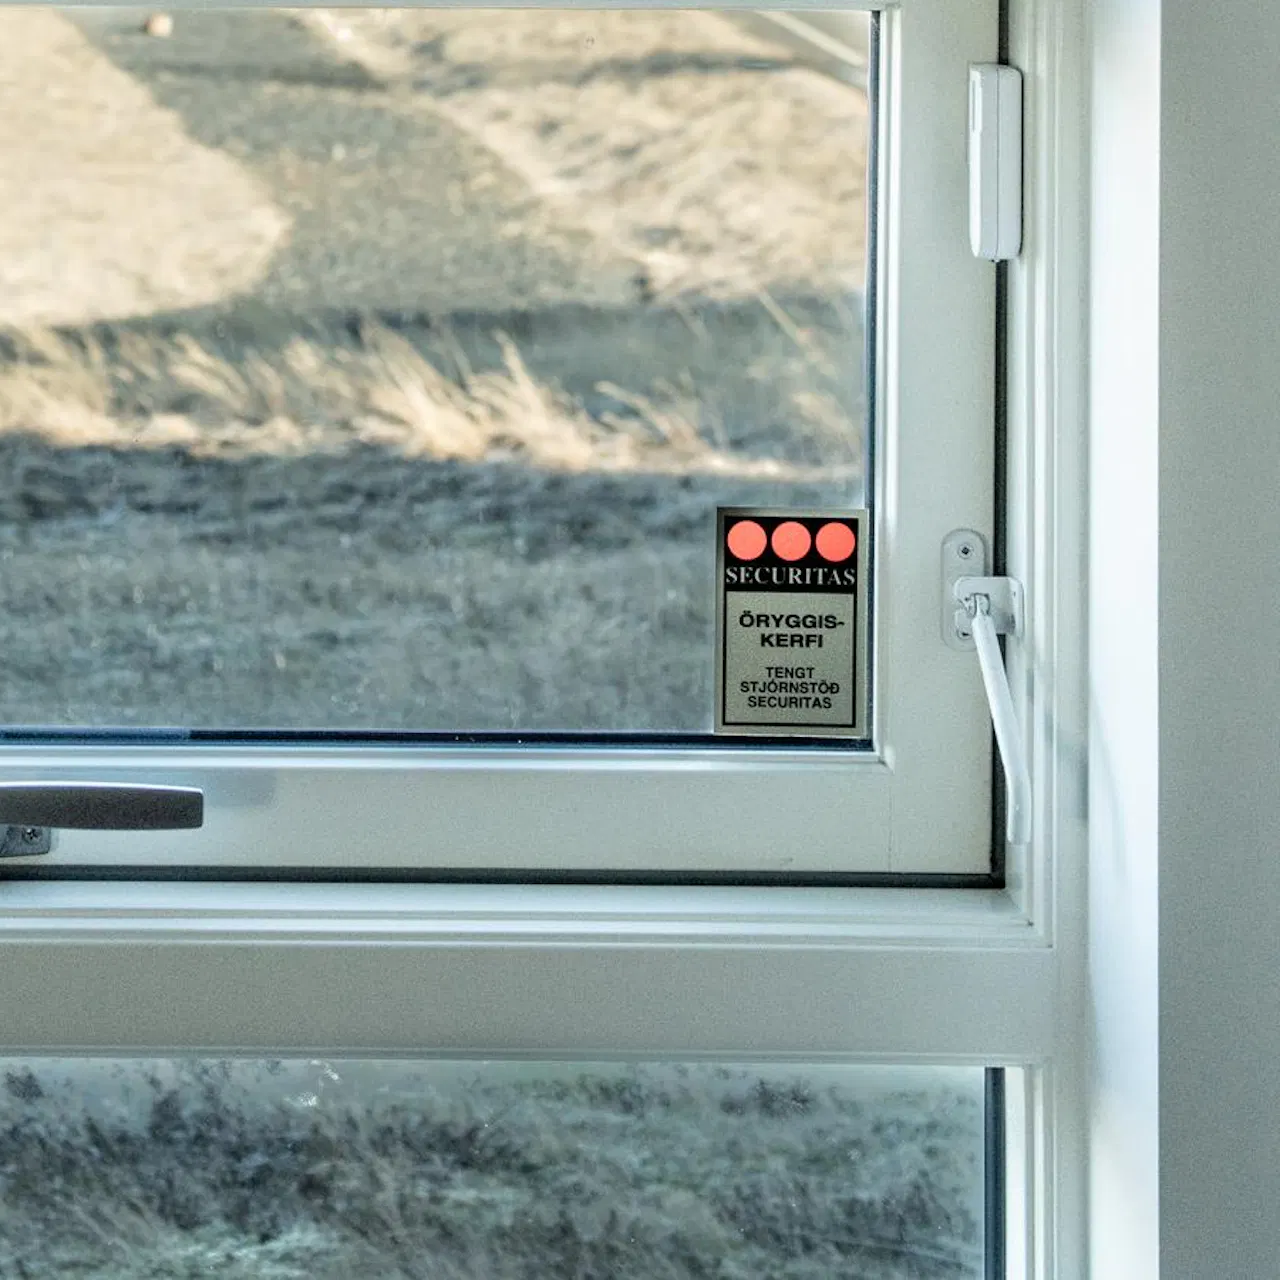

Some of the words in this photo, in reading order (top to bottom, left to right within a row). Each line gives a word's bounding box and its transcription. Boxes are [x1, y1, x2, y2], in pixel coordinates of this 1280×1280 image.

[726, 566, 856, 586] SECURITAS
[739, 610, 845, 629] ÖRYGGIS-
[760, 633, 823, 648] KERFI
[765, 666, 815, 679] TENGT
[740, 678, 840, 694] STJÓRNSTÖÐ
[748, 696, 832, 709] SECURITAS
